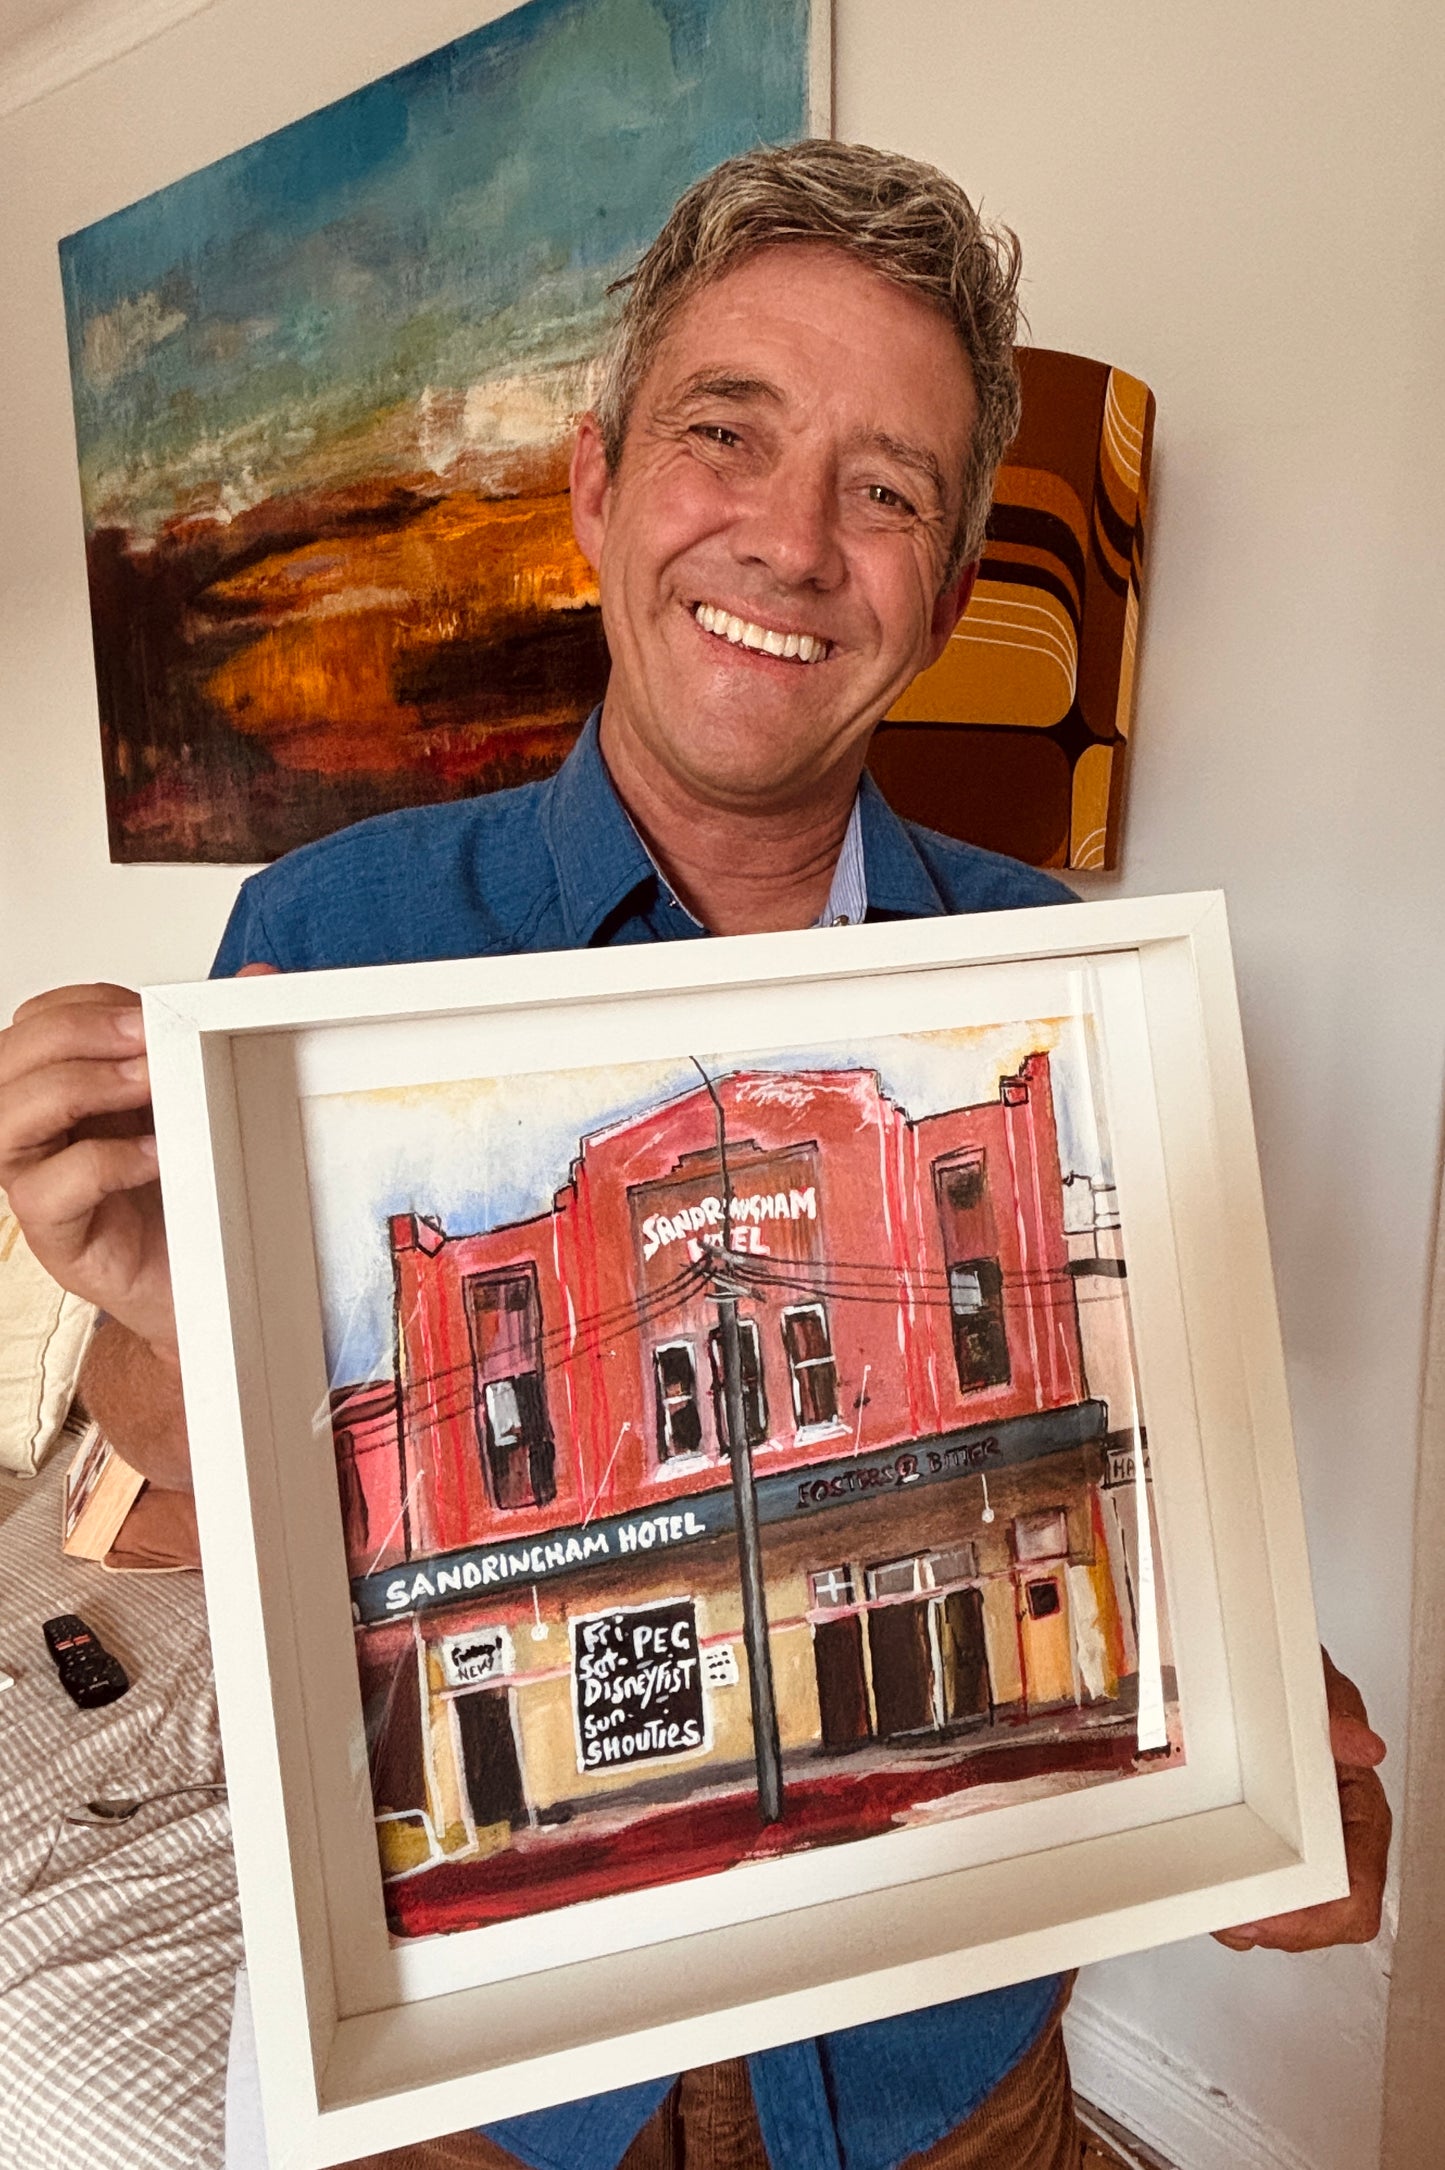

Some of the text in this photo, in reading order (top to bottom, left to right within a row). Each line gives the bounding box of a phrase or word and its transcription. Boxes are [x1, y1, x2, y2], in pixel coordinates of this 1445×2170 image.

[687, 1225, 771, 1263] HOEL
[926, 1436, 1001, 1474] BITTER
[385, 1512, 706, 1611] SANDRINGHAM HOTEL
[632, 1620, 691, 1660] PEG
